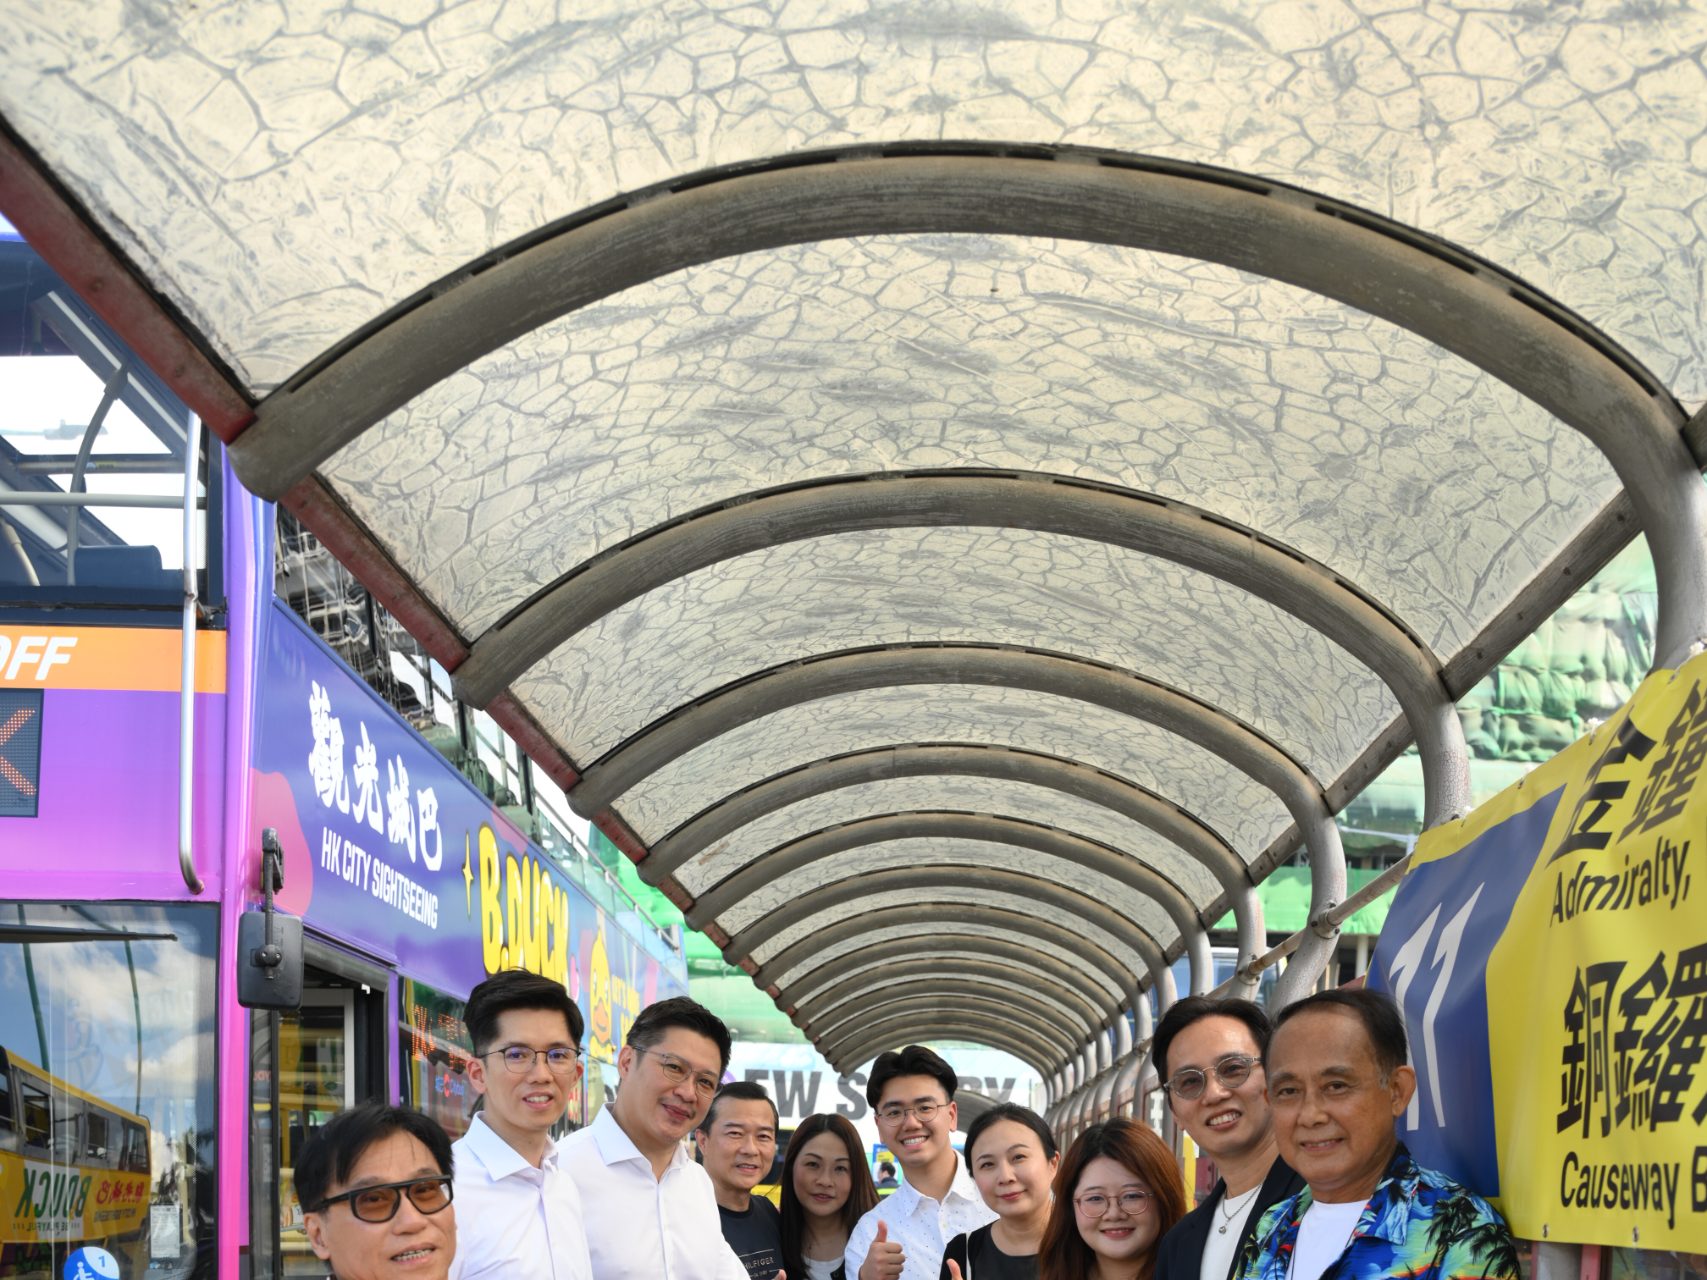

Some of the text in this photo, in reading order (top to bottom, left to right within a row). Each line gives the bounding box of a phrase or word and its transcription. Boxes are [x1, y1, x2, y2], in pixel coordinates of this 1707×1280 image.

[321, 826, 438, 930] HK CITY SIGHTSEEING
[1549, 836, 1691, 927] Admiralty,
[1389, 881, 1486, 1131] 11
[1557, 942, 1707, 1139] 銅鑼
[1560, 1151, 1681, 1231] Causeway
[98, 1255, 106, 1268] 1
